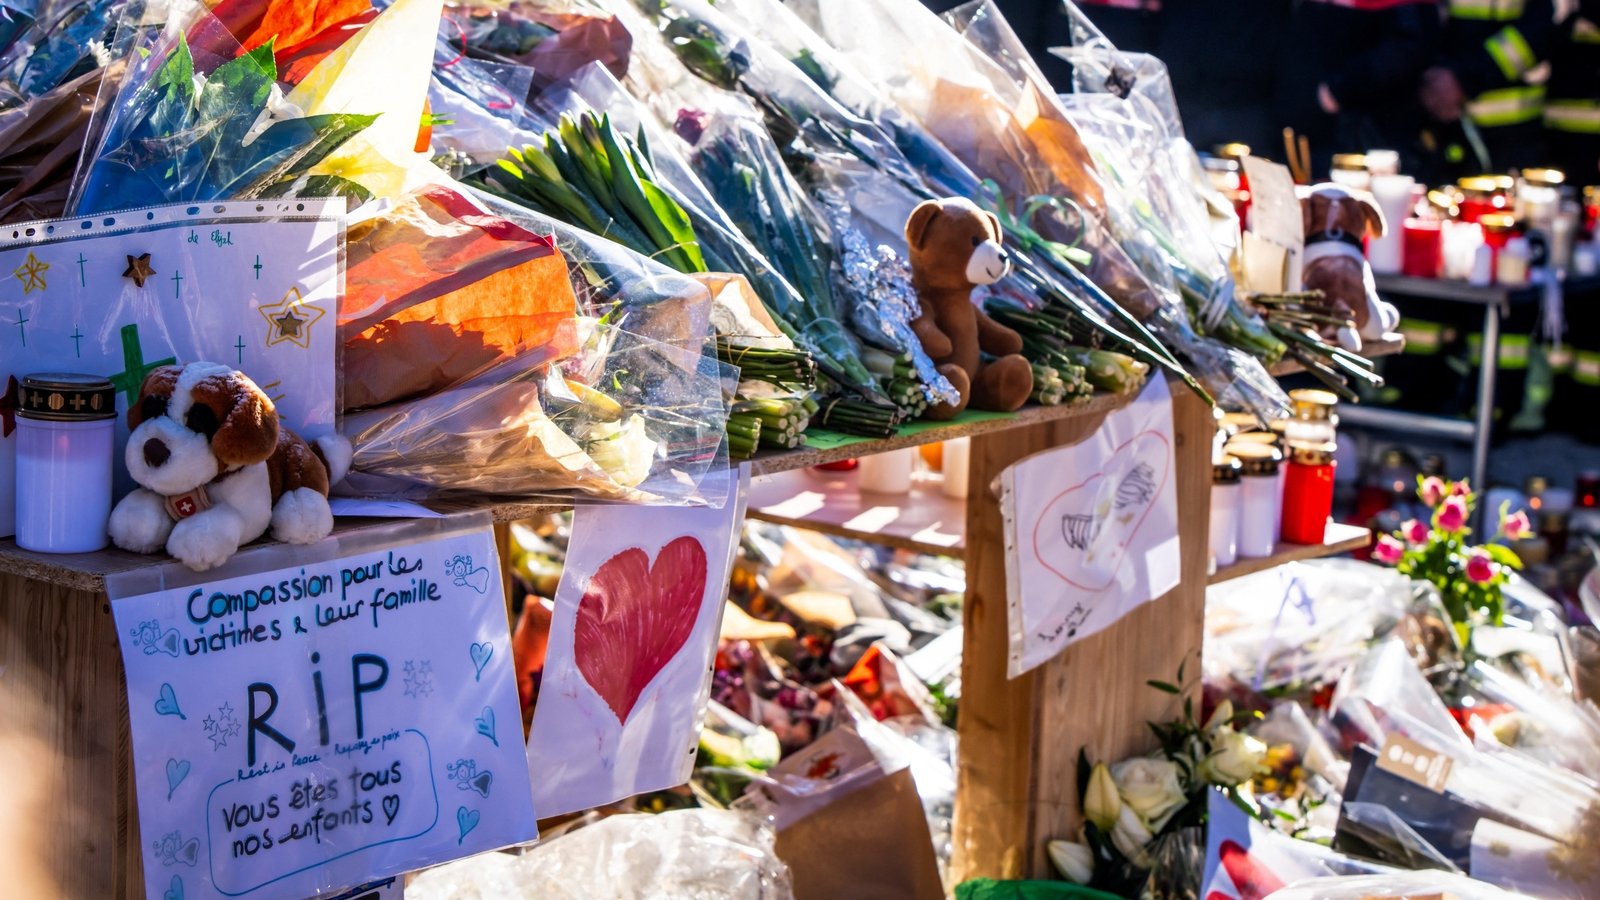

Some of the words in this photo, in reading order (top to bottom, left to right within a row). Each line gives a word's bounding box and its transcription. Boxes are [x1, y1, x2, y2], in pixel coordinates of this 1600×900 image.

[187, 229, 199, 245] de
[183, 618, 282, 656] victimes
[316, 603, 364, 627] leur
[370, 578, 441, 628] famille
[187, 568, 332, 631] Compassion
[341, 561, 383, 600] pour
[238, 763, 269, 781] Rest
[271, 761, 285, 773] in
[382, 728, 401, 750] paix
[289, 777, 338, 809] êtes
[348, 761, 402, 803] tous
[232, 828, 274, 858] nos
[278, 801, 374, 845] enfants
